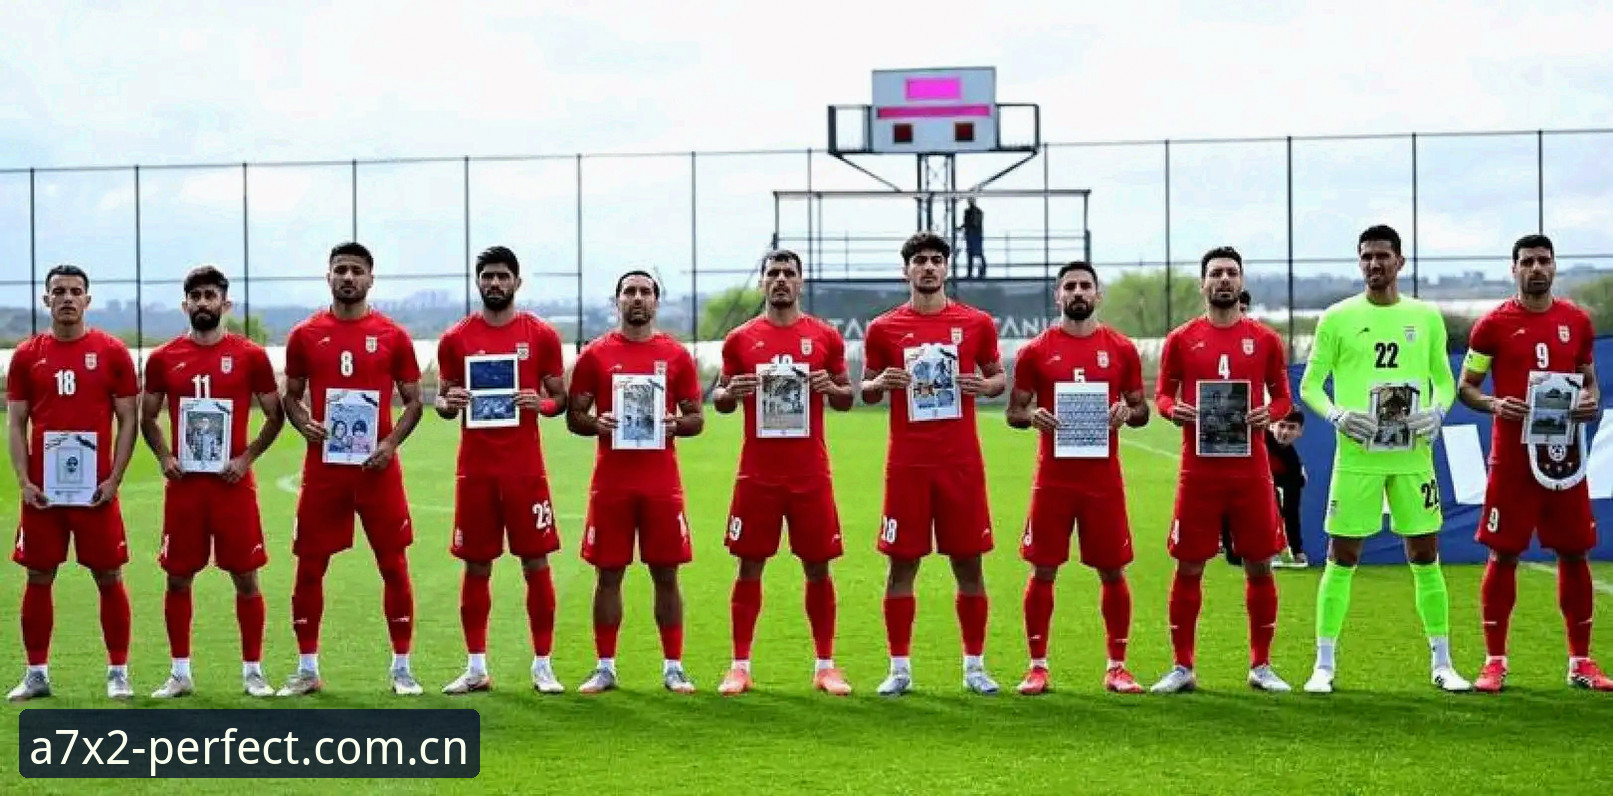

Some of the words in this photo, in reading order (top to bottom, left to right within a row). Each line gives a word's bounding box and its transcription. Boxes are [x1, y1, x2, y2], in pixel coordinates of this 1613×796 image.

[340, 350, 353, 377] 8
[1218, 353, 1230, 380] 4
[1374, 342, 1399, 368] 22
[1535, 342, 1549, 368] 9
[54, 369, 76, 395] 18
[191, 374, 210, 399] 11
[1487, 507, 1499, 533] 9
